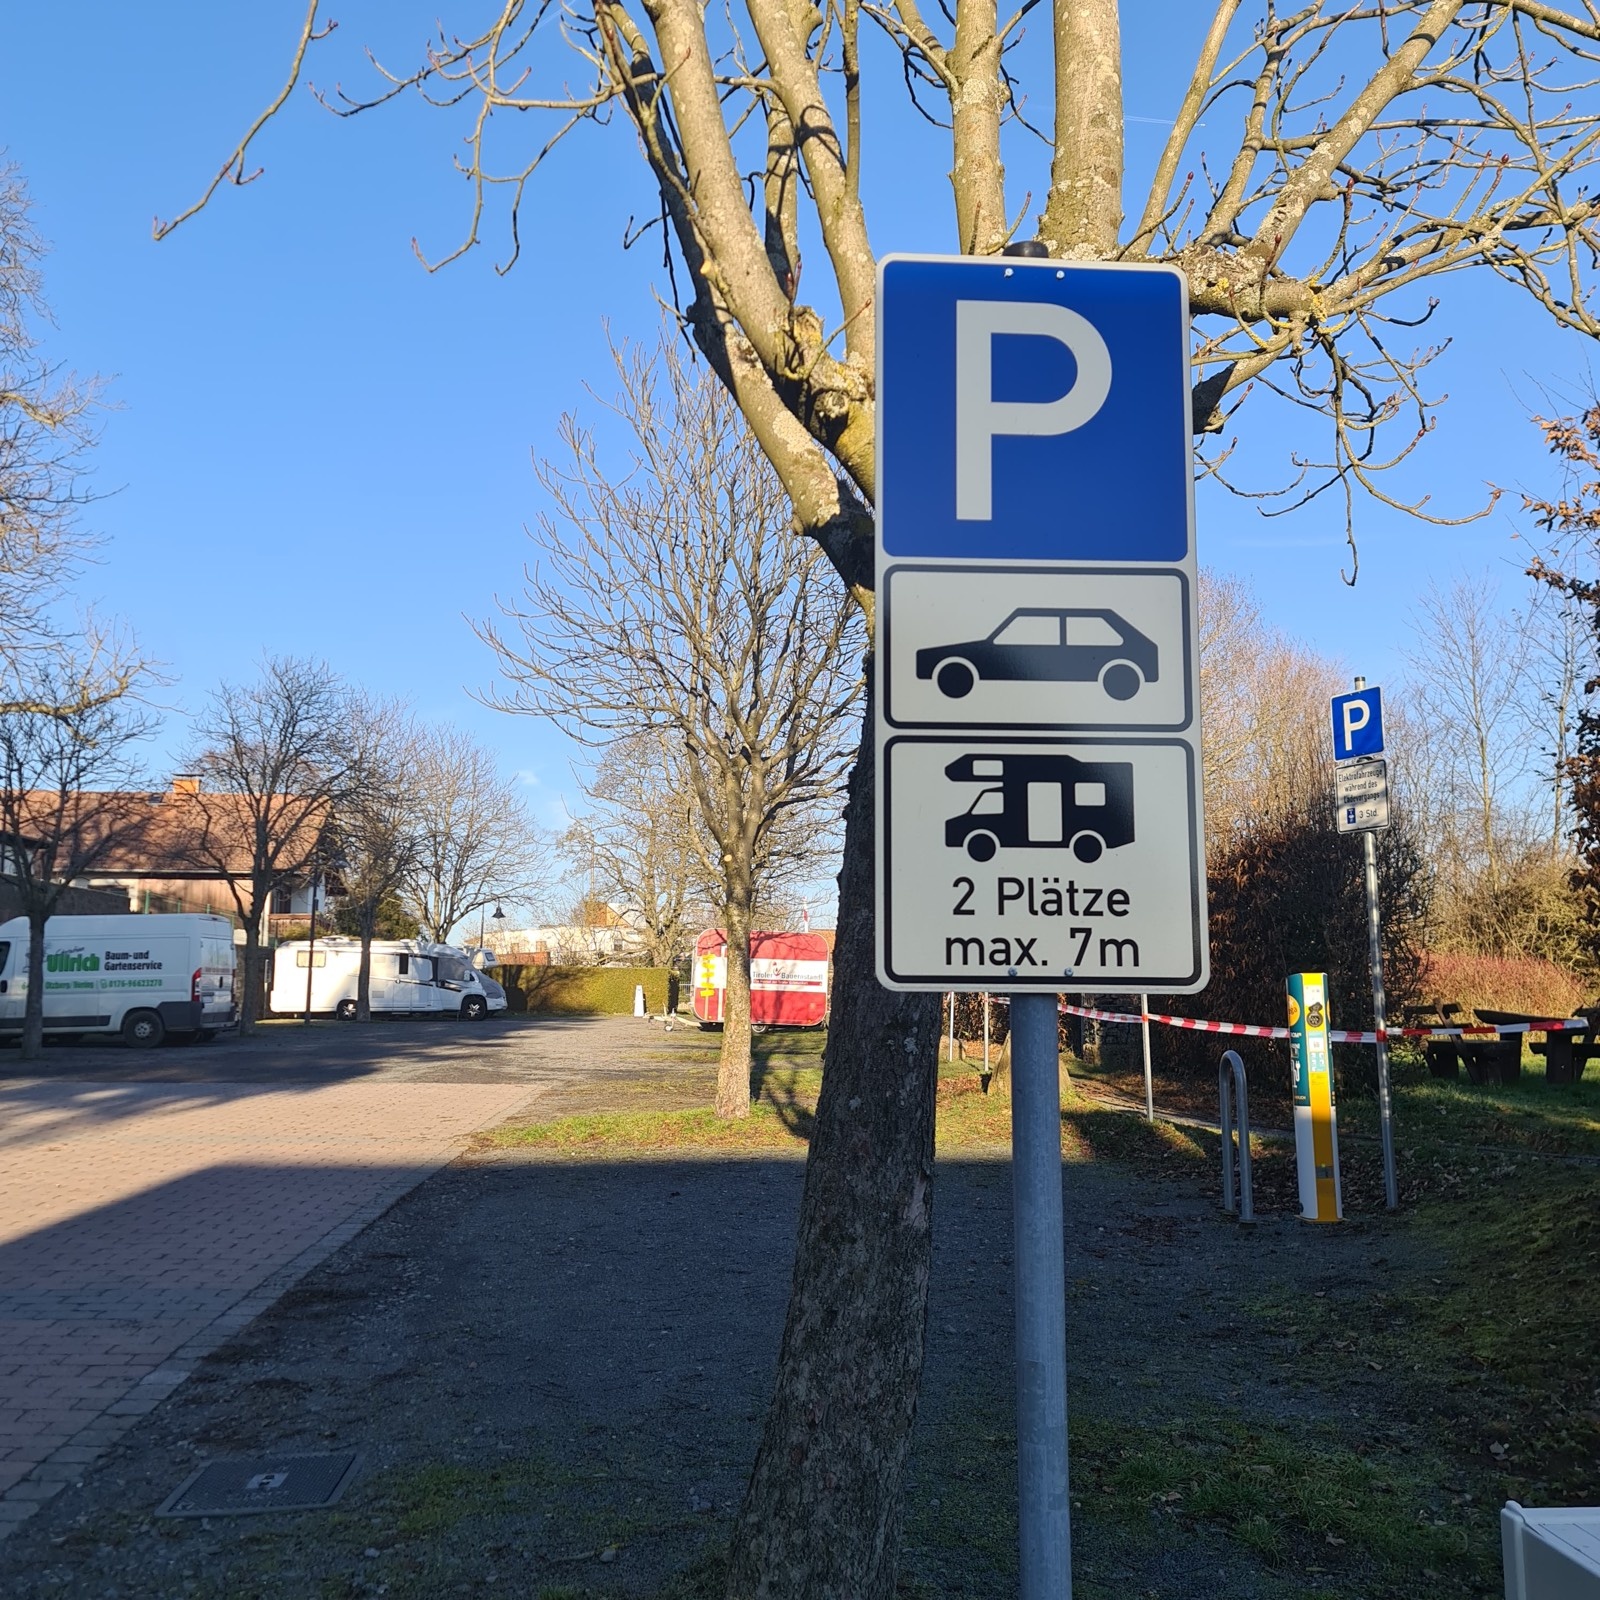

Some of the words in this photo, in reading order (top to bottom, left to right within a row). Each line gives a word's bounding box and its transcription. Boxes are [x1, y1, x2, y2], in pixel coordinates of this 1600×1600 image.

[956, 299, 1112, 521] P
[1343, 699, 1370, 751] P
[1338, 769, 1383, 783] Elektrofahrzeuge
[1344, 781, 1367, 792] während
[1368, 780, 1378, 789] des
[1359, 810, 1364, 819] 3
[952, 876, 976, 916] 2
[997, 876, 1131, 917] Plätze
[105, 951, 132, 960] Baum-
[133, 950, 150, 960] und
[945, 936, 1049, 967] max.
[1069, 927, 1140, 968] 7m
[46, 953, 100, 973] Ullrich
[104, 960, 163, 971] Gartenservice
